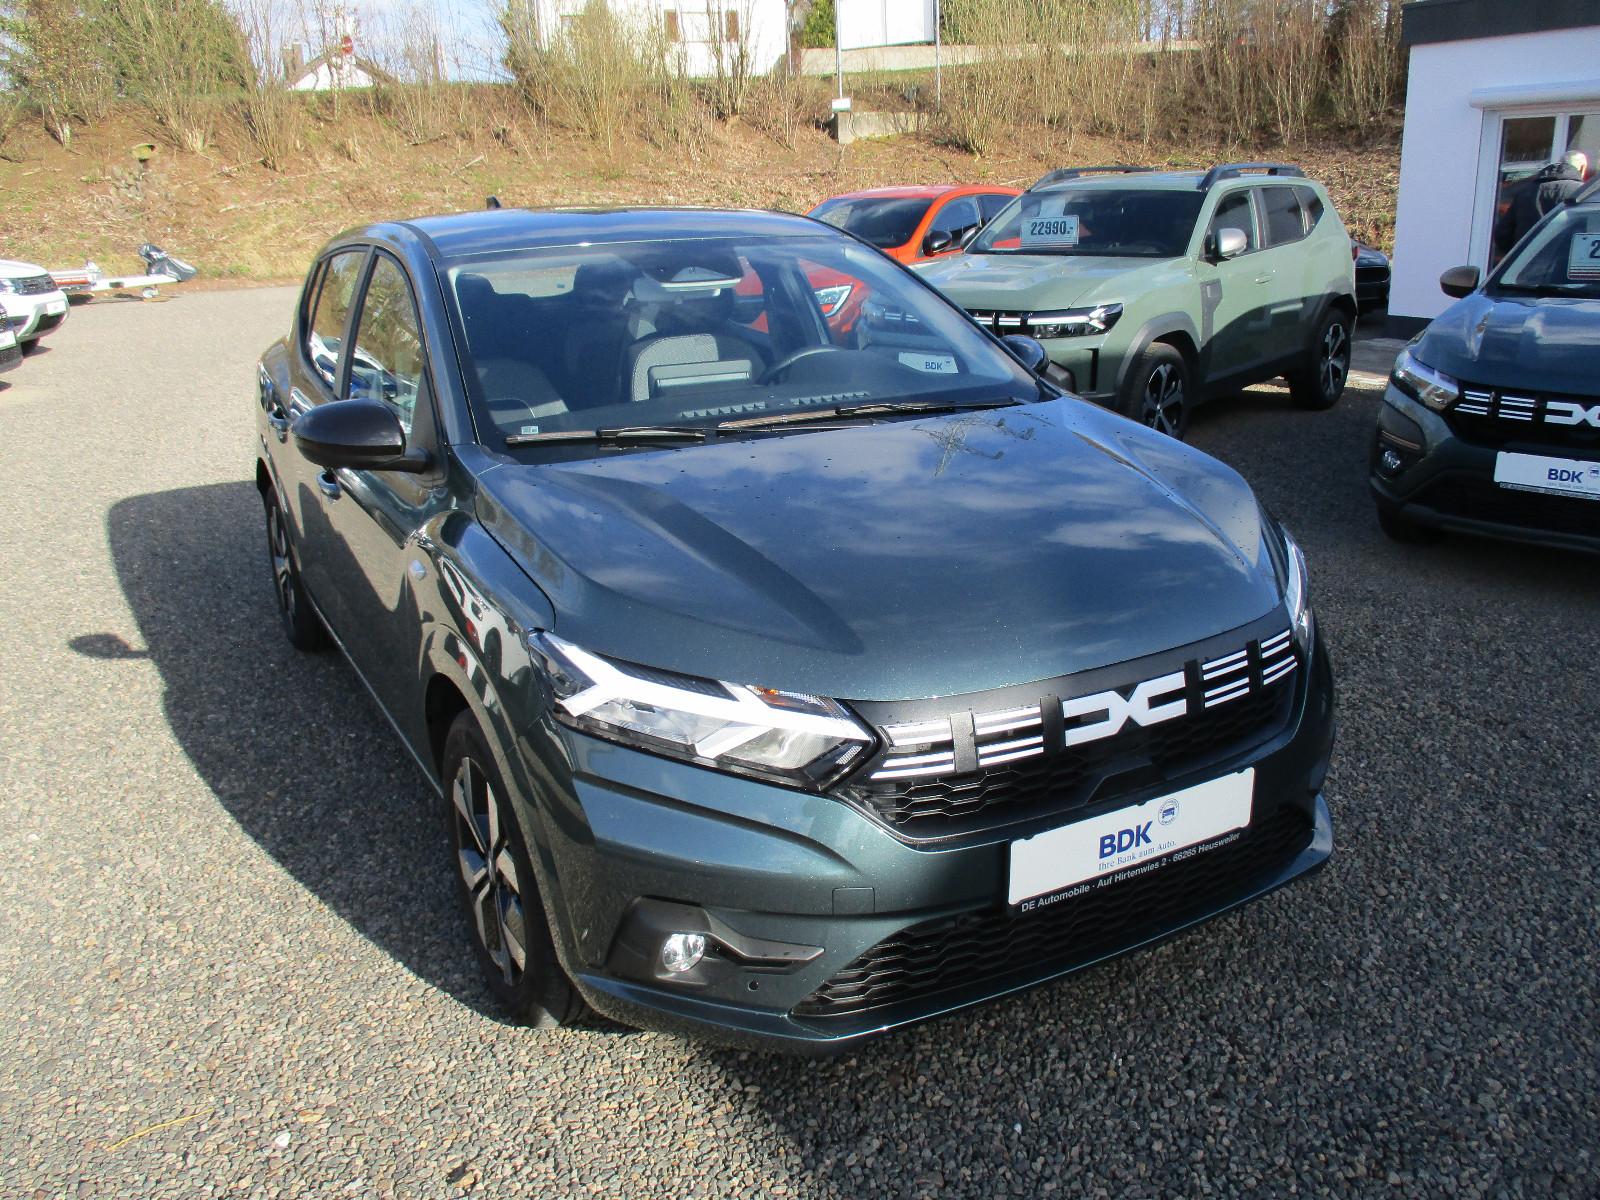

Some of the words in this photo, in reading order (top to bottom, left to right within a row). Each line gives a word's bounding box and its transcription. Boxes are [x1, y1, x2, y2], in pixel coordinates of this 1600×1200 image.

[925, 361, 943, 371] BDK
[1547, 467, 1584, 484] BDK
[1098, 820, 1153, 860] BDK
[1098, 862, 1115, 871] Ihre
[1117, 851, 1137, 865] Bank
[1139, 848, 1155, 858] zum
[1157, 840, 1177, 852] Auto.
[1021, 900, 1036, 913] DE
[1037, 884, 1091, 908] Automobile
[1097, 876, 1114, 889] Auf
[1114, 862, 1160, 883] Hirtenwies
[1161, 857, 1167, 867] 2
[1198, 832, 1241, 854] Heusweiler
